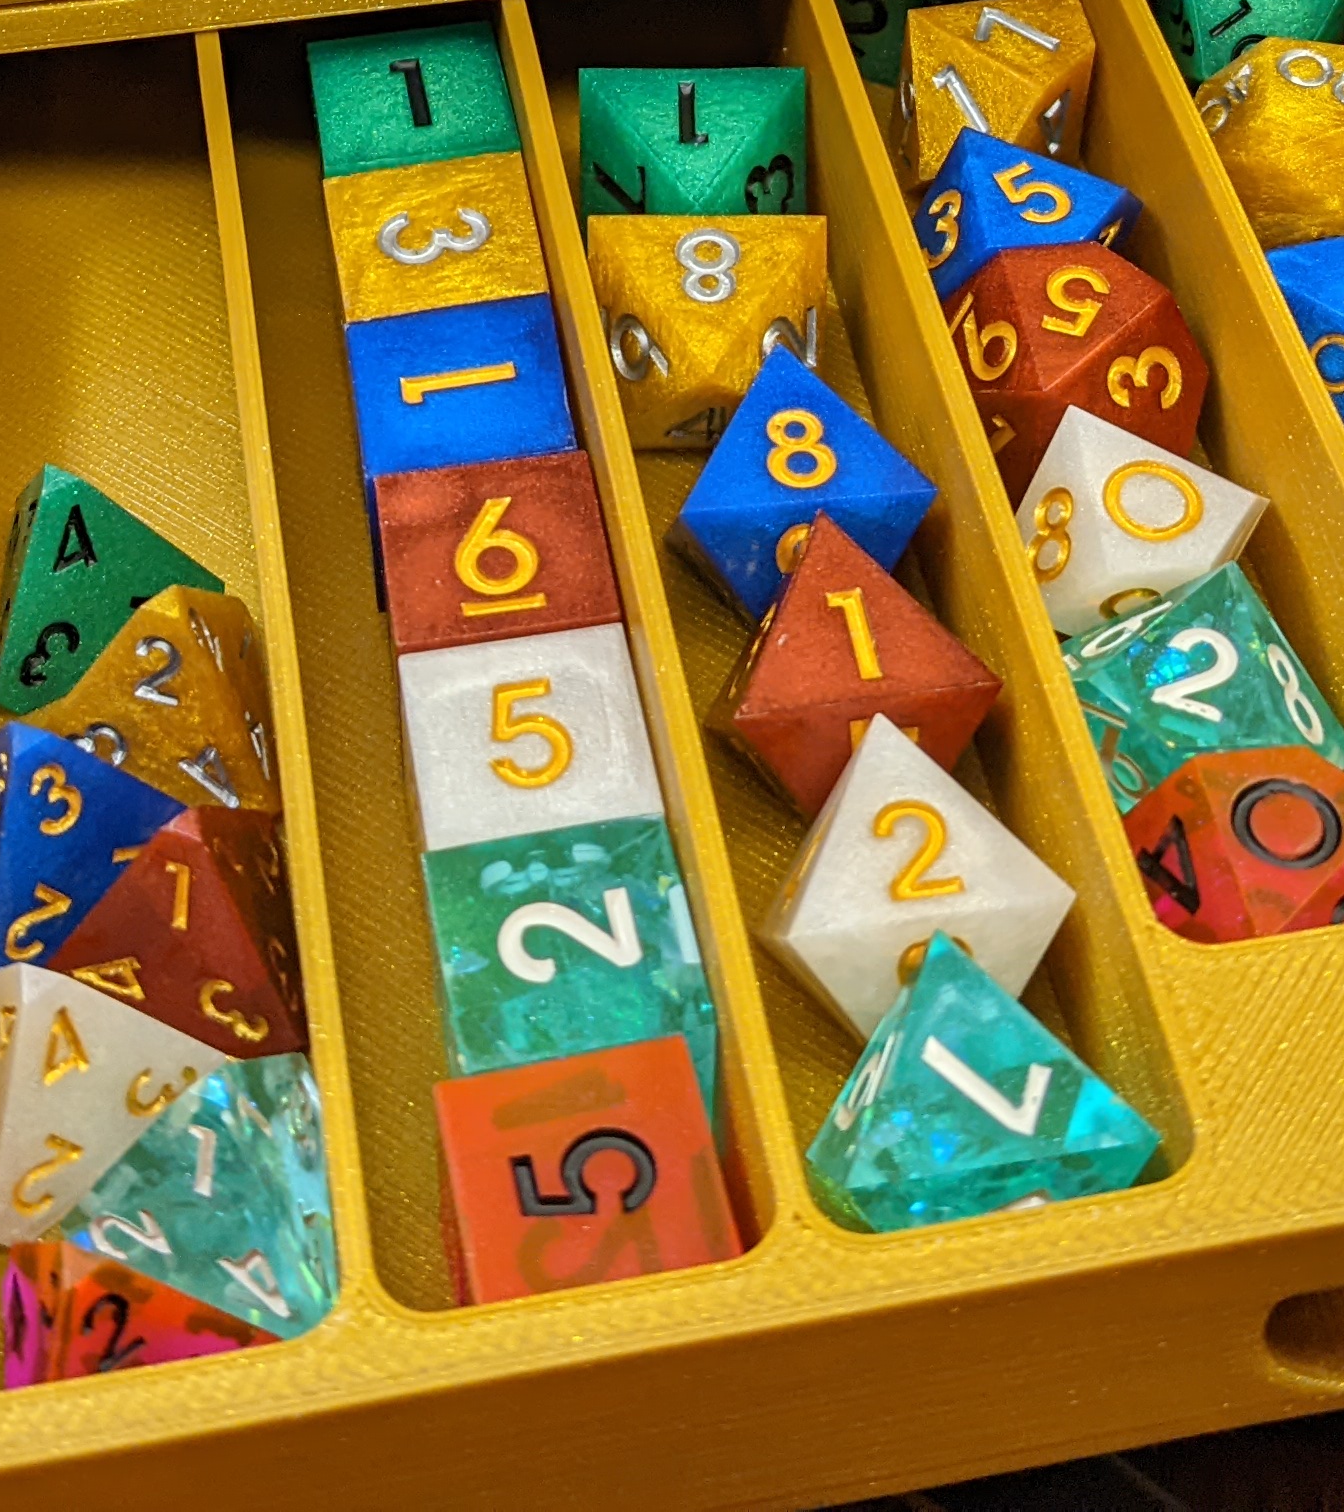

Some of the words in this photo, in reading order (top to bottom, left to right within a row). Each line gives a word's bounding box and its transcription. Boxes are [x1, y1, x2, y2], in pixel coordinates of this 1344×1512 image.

[389, 58, 431, 127] 1
[677, 80, 709, 145] 1
[922, 189, 962, 270] 3
[993, 161, 1072, 224] 5
[378, 207, 491, 264] 3
[676, 228, 741, 303] 8
[1041, 265, 1111, 338] 5
[399, 362, 516, 405] 1
[1107, 345, 1182, 410] 3
[766, 409, 837, 489] 8
[53, 504, 98, 572] 4
[1028, 486, 1074, 583] 8
[1103, 460, 1204, 542] 0
[455, 496, 547, 617] 6
[19, 621, 80, 687] 3
[134, 636, 182, 707] 2
[825, 586, 884, 681] 1
[1151, 627, 1239, 722] 2
[1266, 643, 1324, 745] 8
[489, 678, 573, 787] 5
[30, 763, 83, 837] 3
[178, 746, 240, 809] 4
[872, 800, 965, 902] 2
[1231, 778, 1342, 870] 0
[165, 861, 191, 931] 1
[1138, 815, 1200, 916] 4
[5, 882, 72, 961] 2
[497, 887, 643, 983] 2
[44, 1005, 90, 1086] 4
[199, 979, 269, 1042] 3
[12, 1134, 84, 1217] 2
[188, 1124, 217, 1197] 1
[509, 1127, 658, 1216] 5
[89, 1209, 172, 1260] 2
[216, 1248, 292, 1319] 4
[82, 1293, 145, 1372] 2
